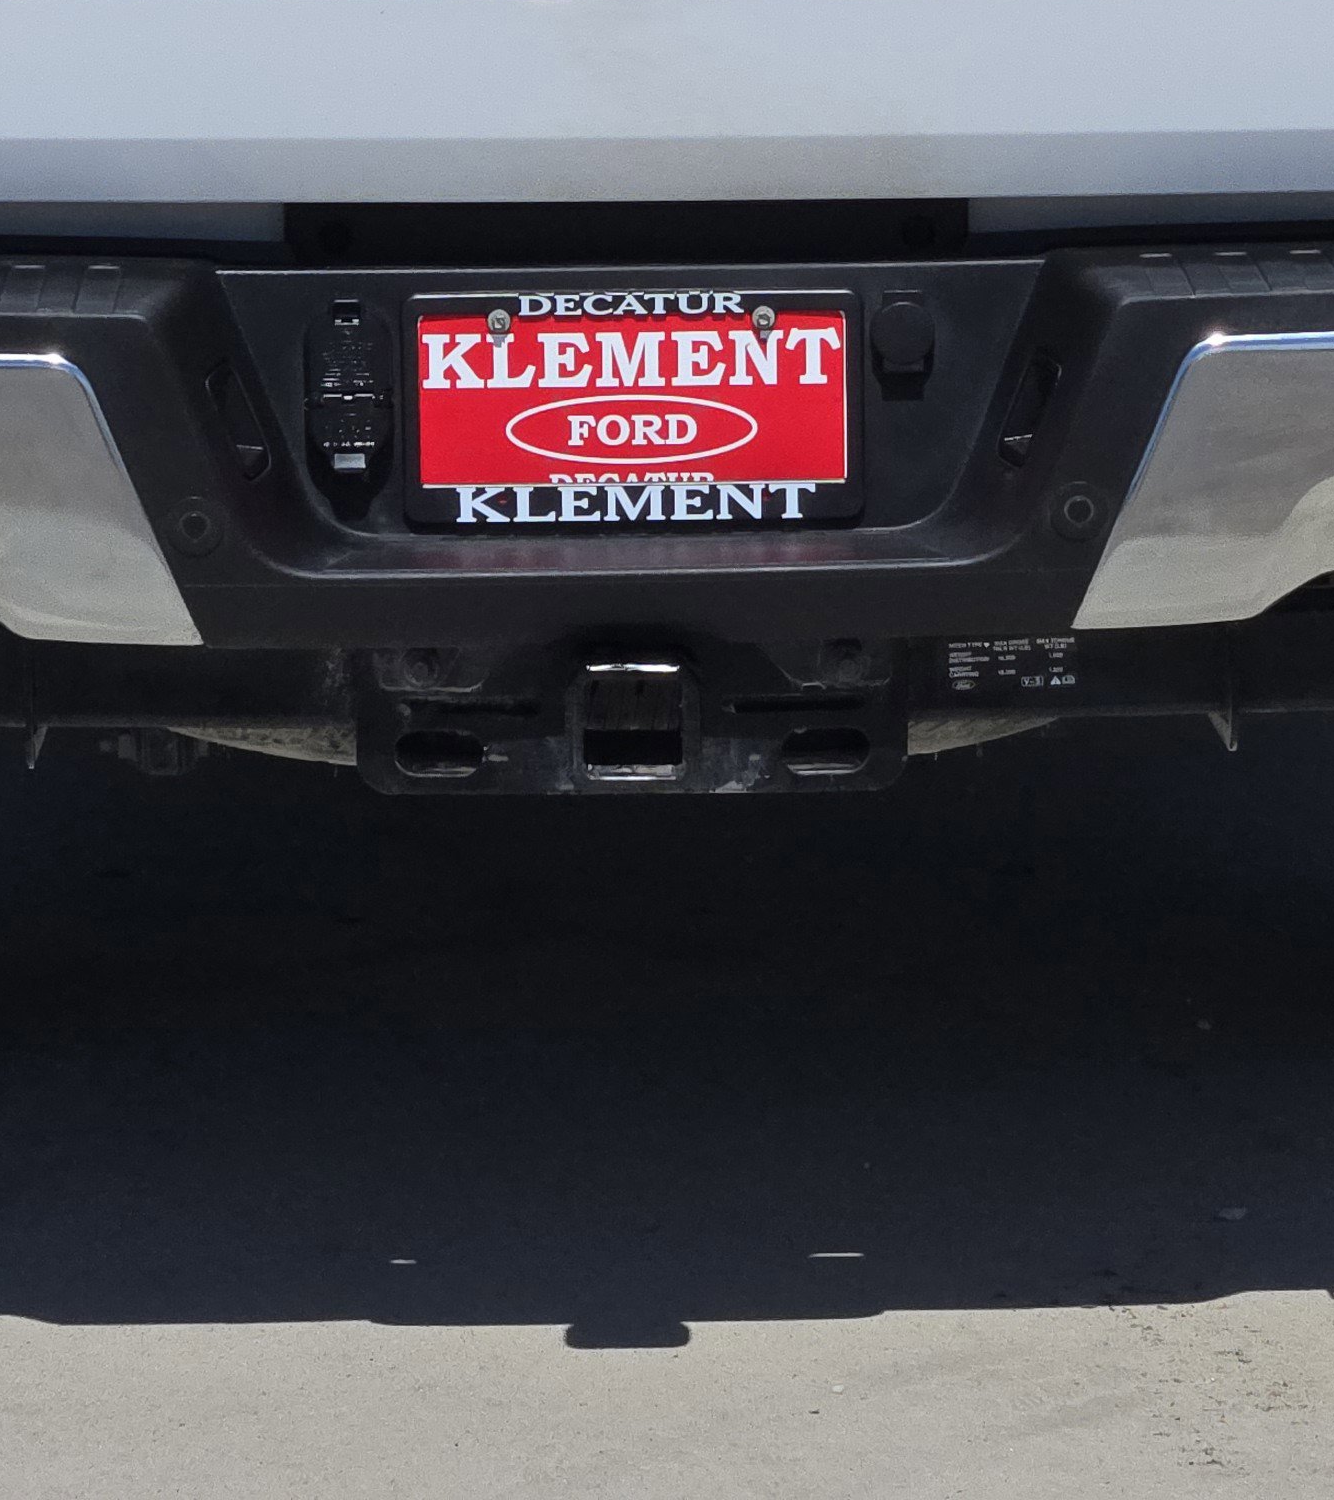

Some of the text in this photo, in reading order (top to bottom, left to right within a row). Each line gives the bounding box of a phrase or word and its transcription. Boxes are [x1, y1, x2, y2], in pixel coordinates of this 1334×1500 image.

[517, 291, 746, 318] DECATUR
[421, 327, 841, 390] KLEMENT
[567, 414, 698, 446] FORD
[455, 482, 817, 524] KLEMENT
